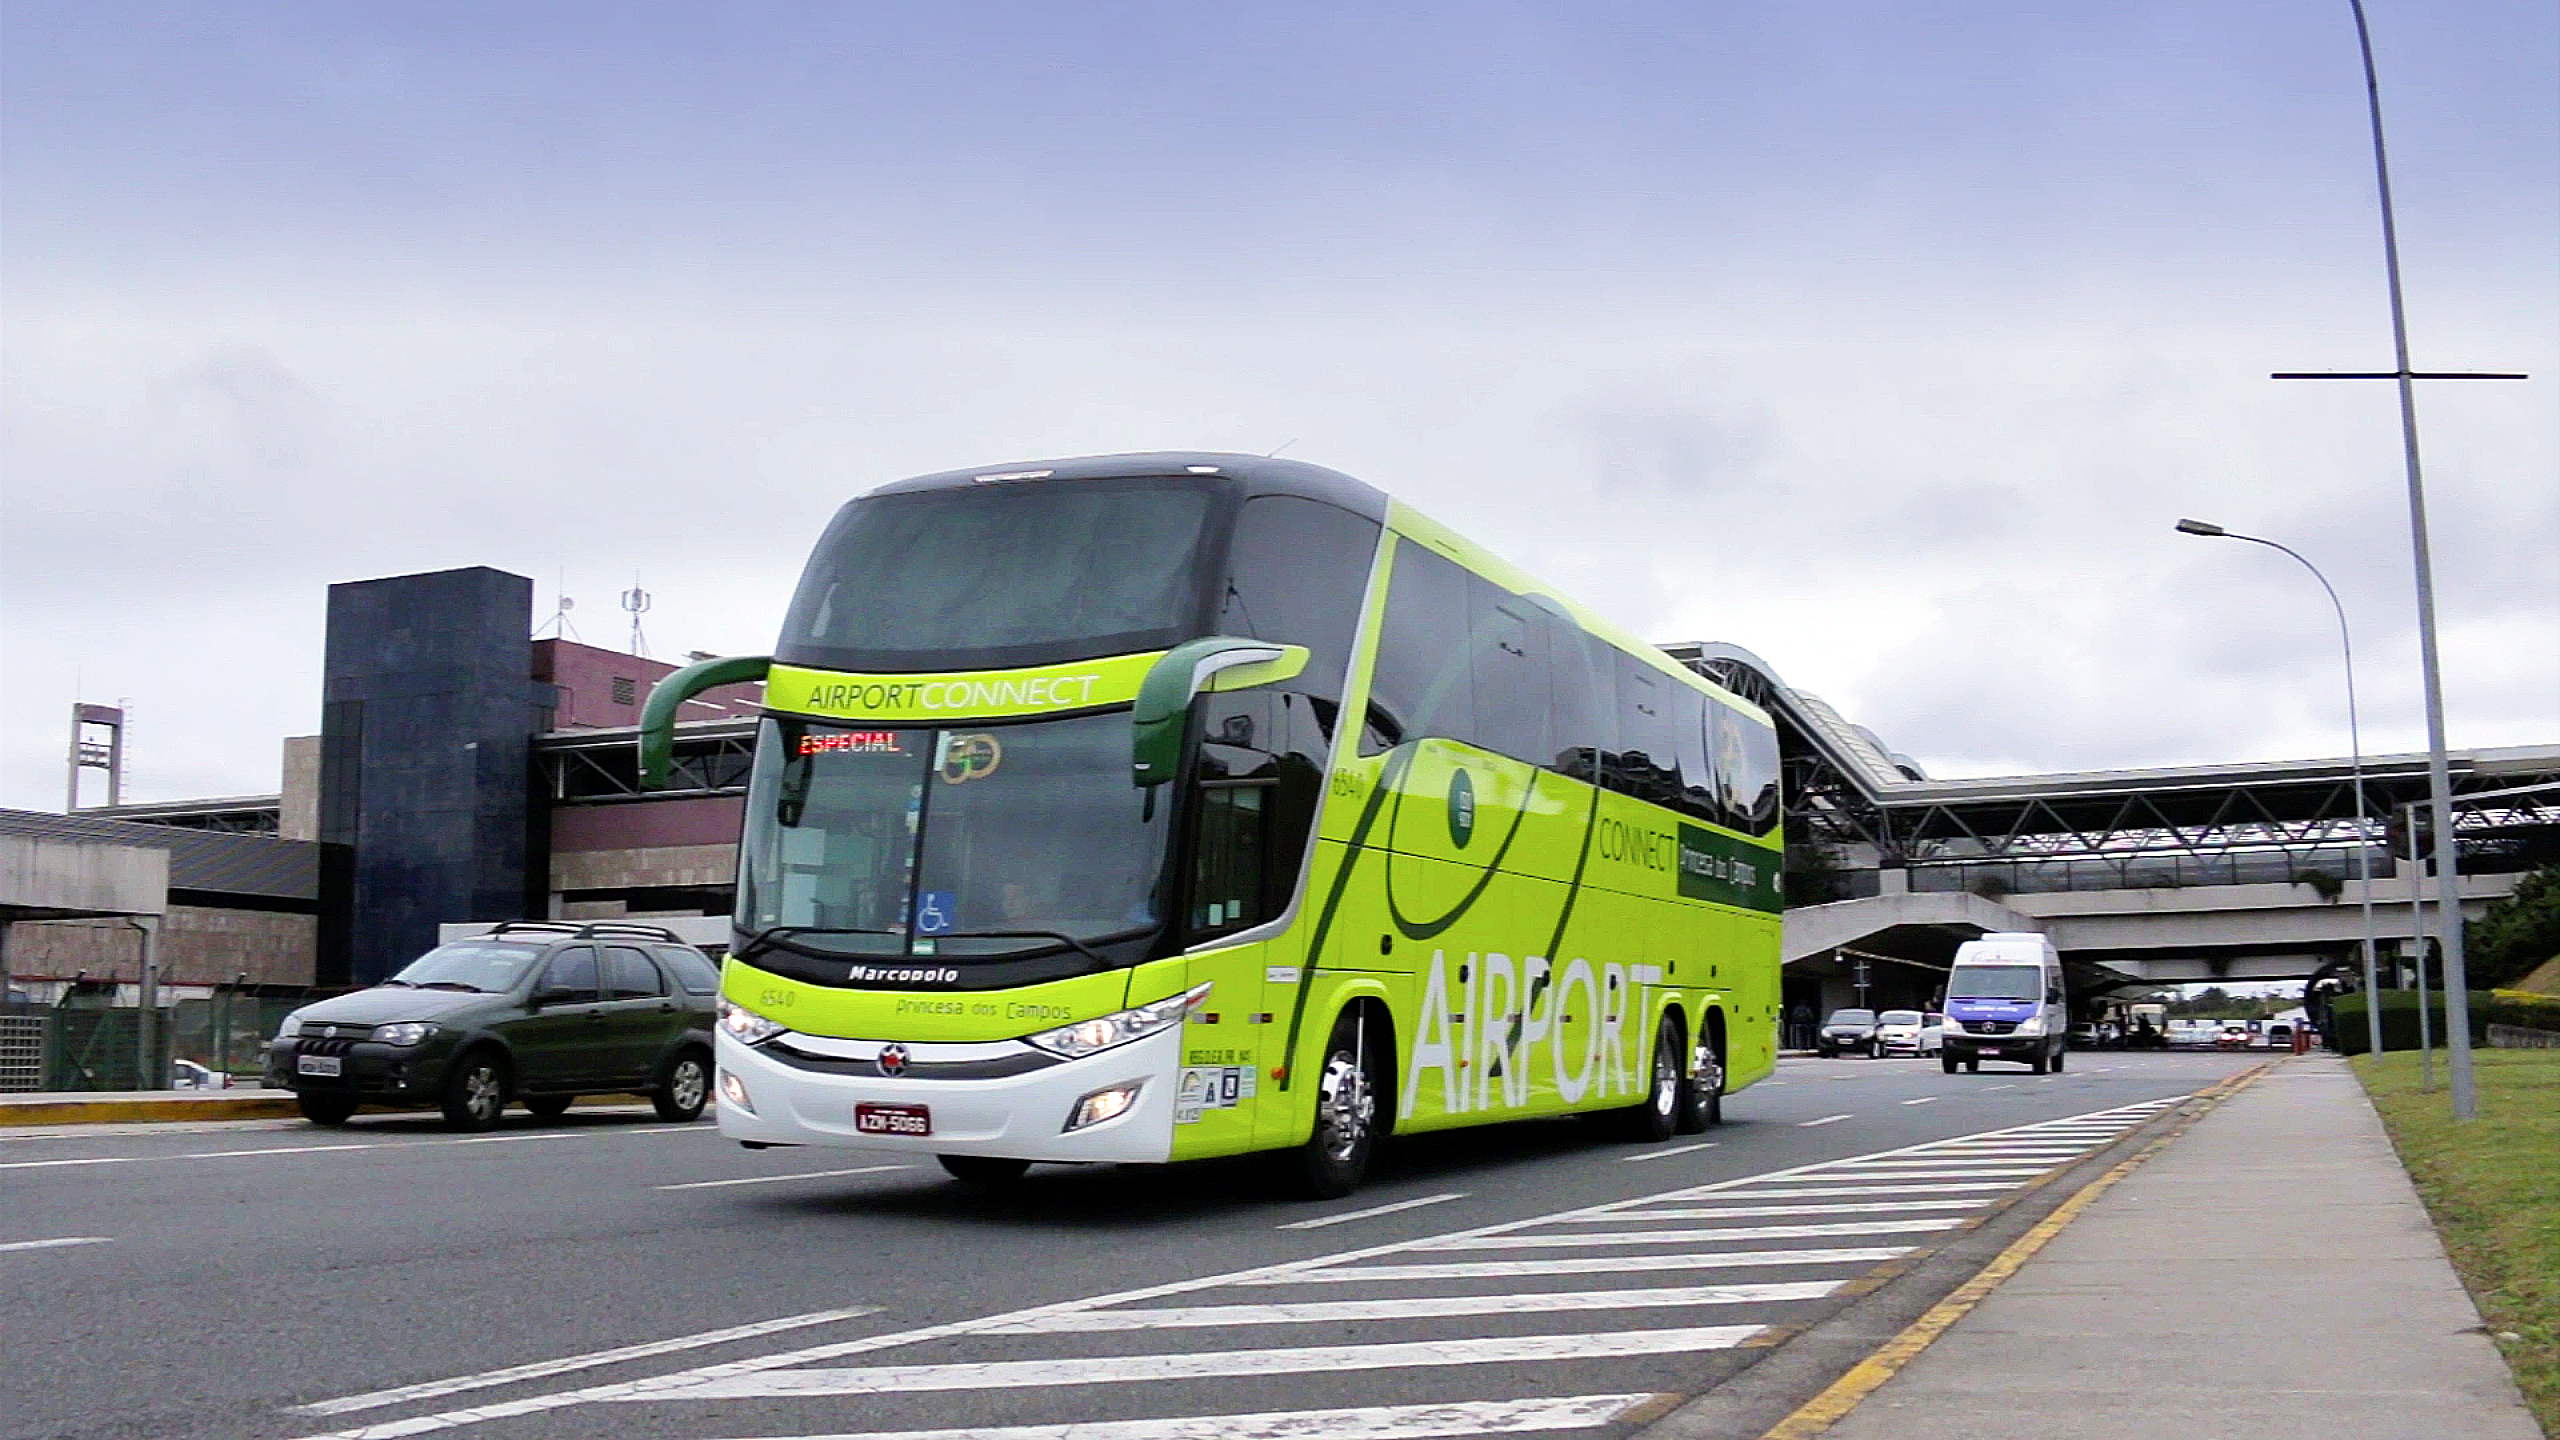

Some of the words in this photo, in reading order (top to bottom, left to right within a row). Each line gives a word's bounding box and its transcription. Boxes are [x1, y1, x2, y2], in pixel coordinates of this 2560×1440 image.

[800, 733, 900, 755] ESPECIAL
[1600, 818, 1674, 872] CONNECT
[848, 965, 959, 982] Marcopolo
[759, 989, 796, 1009] 6540
[895, 999, 964, 1014] Princesa
[971, 1003, 997, 1016] dos
[1005, 1002, 1072, 1020] Campos
[1400, 948, 1663, 1119] AIRPORT
